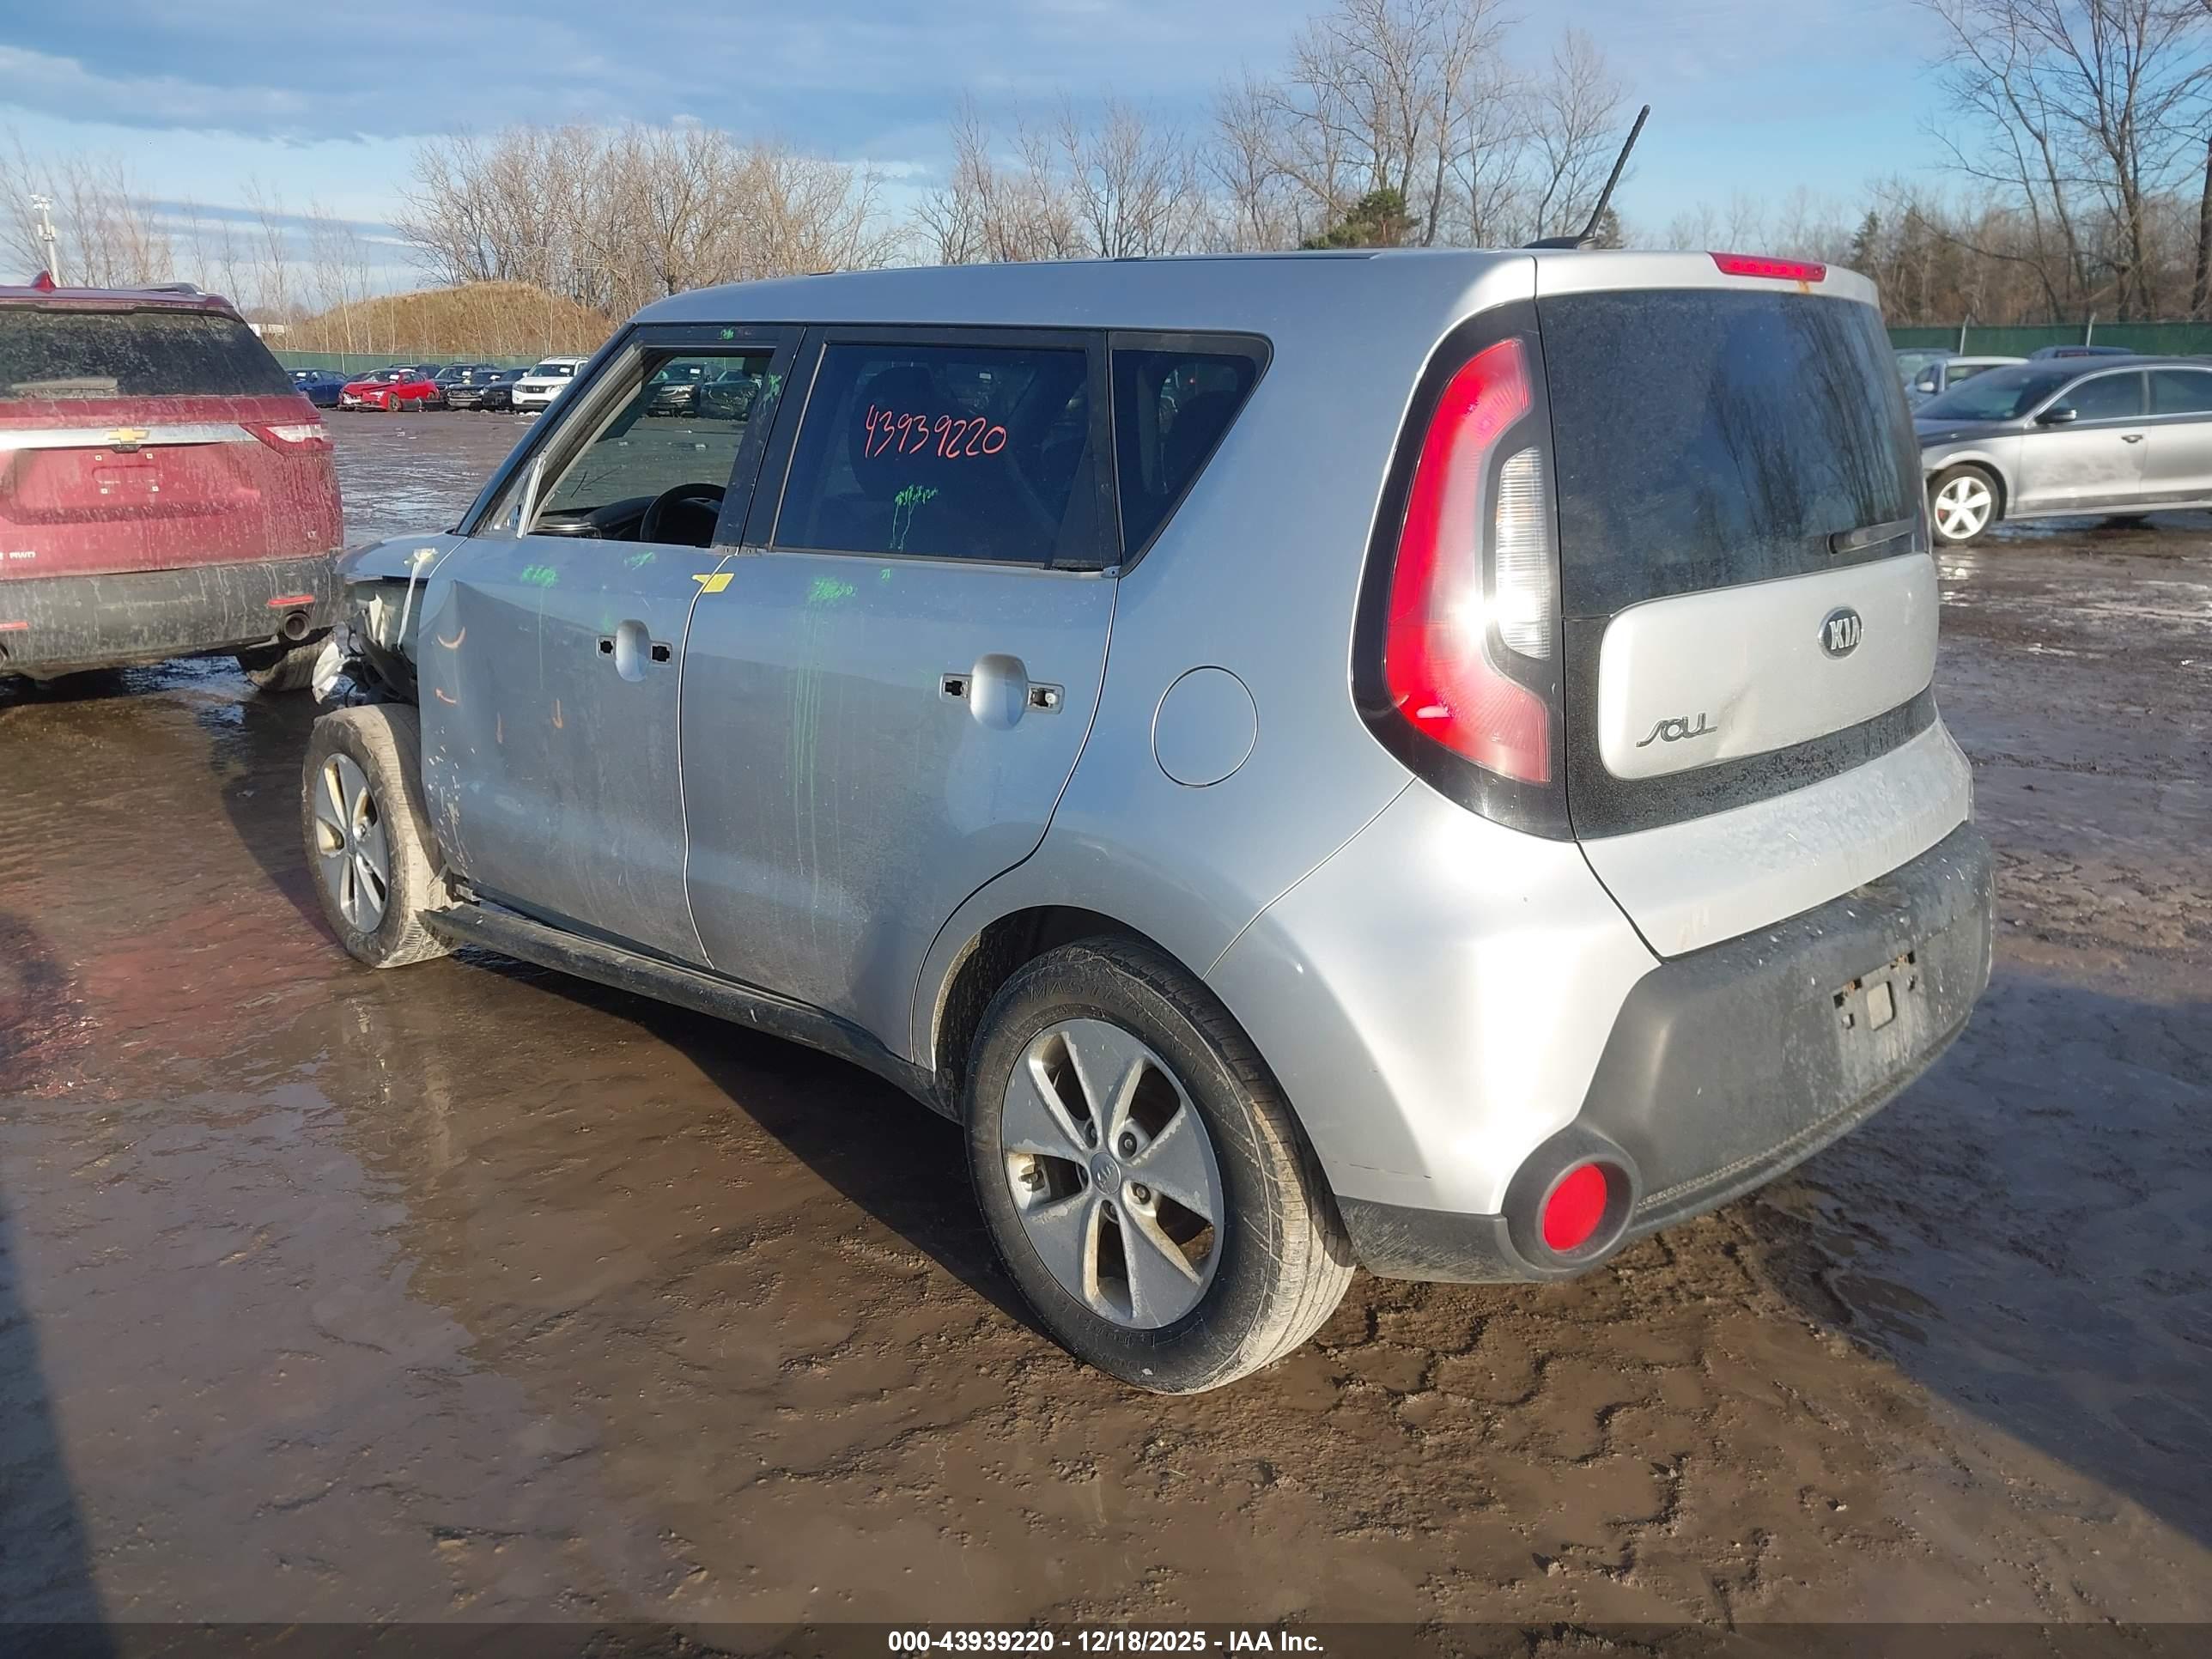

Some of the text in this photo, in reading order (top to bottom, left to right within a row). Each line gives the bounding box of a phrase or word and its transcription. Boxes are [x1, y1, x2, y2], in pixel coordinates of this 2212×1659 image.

[865, 404, 1007, 459] 43939220
[1828, 615, 1860, 650] KIA
[1635, 712, 1718, 748] SOUL
